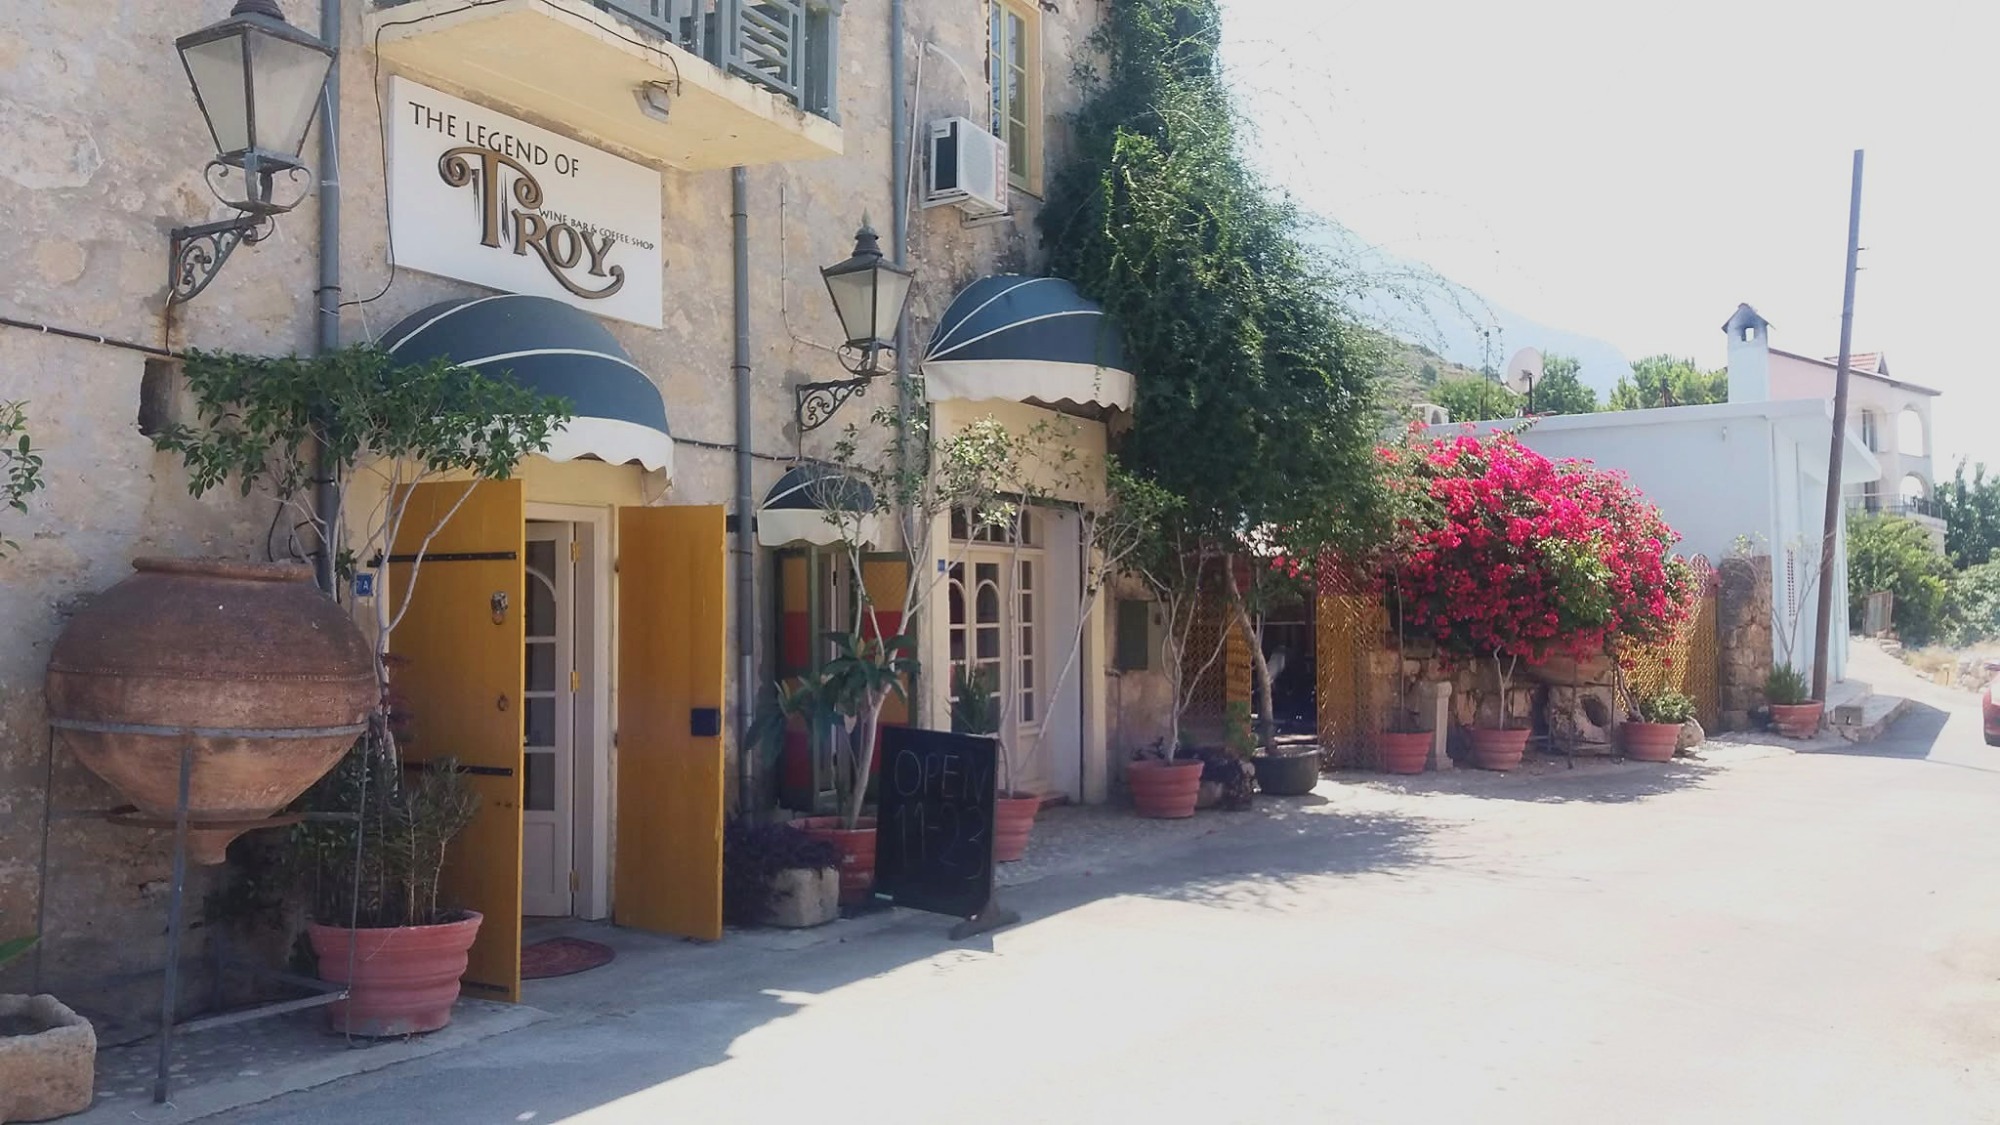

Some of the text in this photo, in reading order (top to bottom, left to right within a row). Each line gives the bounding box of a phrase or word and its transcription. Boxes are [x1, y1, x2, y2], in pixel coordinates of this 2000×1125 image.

[408, 101, 579, 178] THE LEGEND OF
[539, 208, 655, 251] WINE BAR & COFFEE SHOP
[894, 749, 989, 804] OPEN
